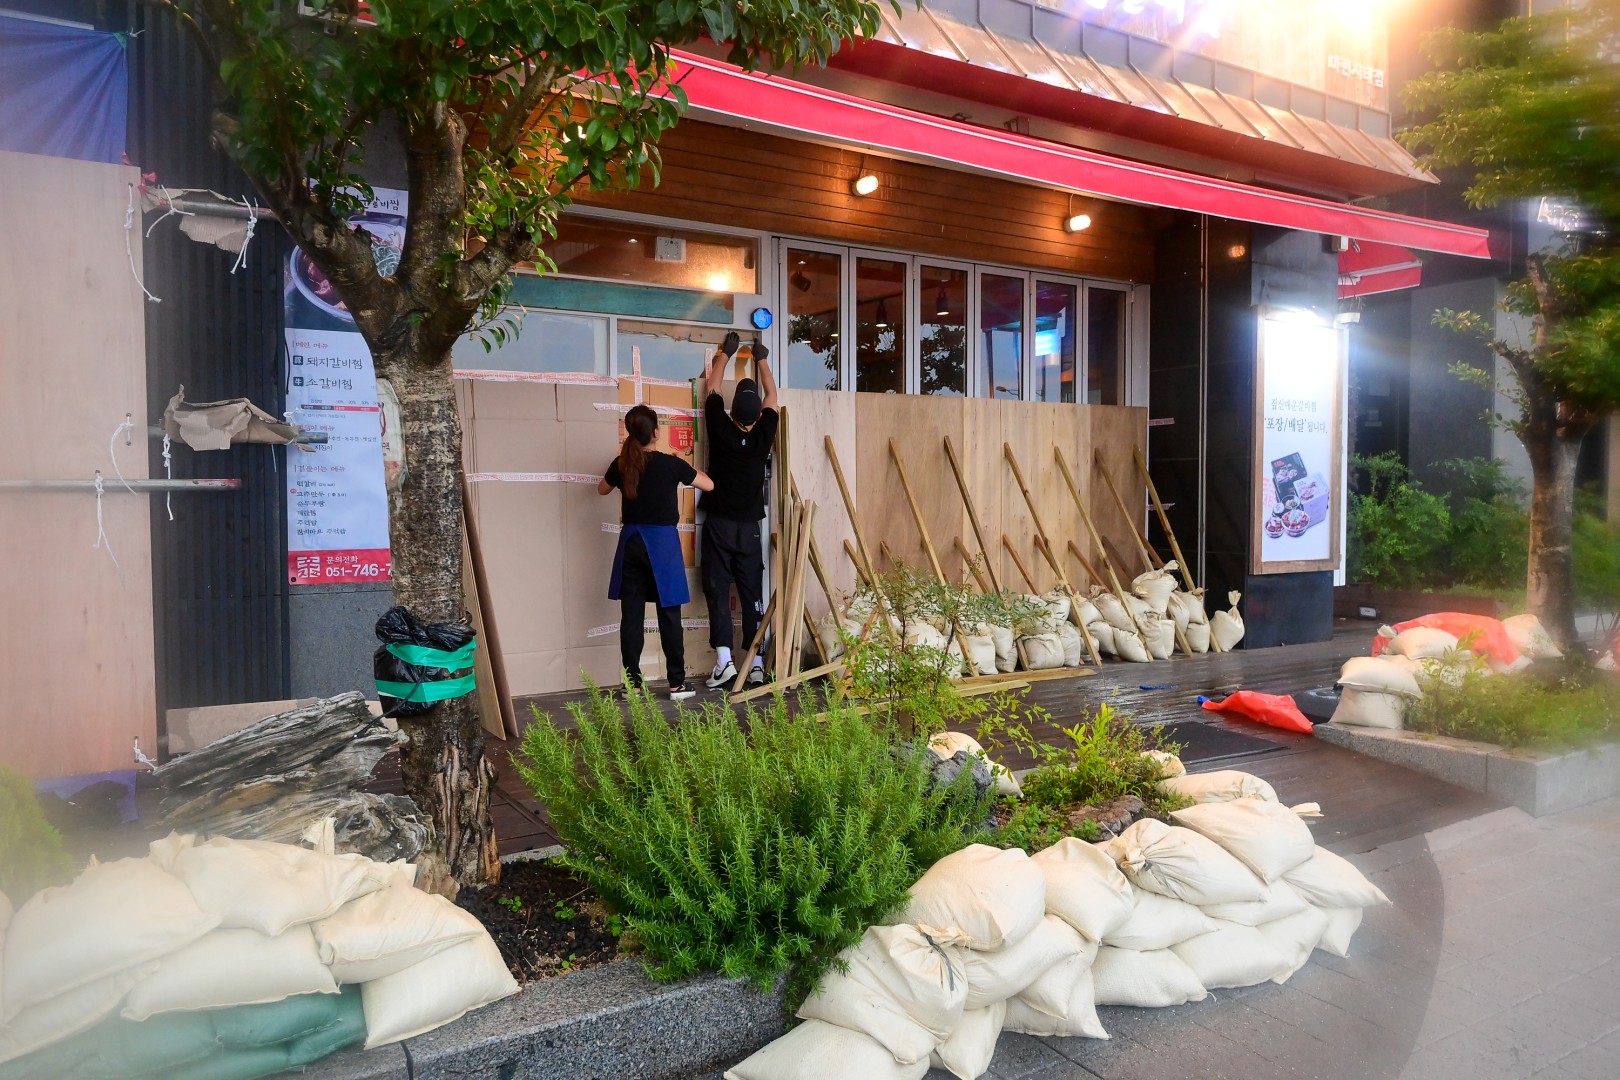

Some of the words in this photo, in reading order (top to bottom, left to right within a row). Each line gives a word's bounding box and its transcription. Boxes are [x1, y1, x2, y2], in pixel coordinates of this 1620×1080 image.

[296, 340, 310, 348] 메인
[306, 356, 362, 370] 돼지갈비찜
[306, 378, 352, 390] 소갈비찜
[326, 556, 358, 564] 문의전화
